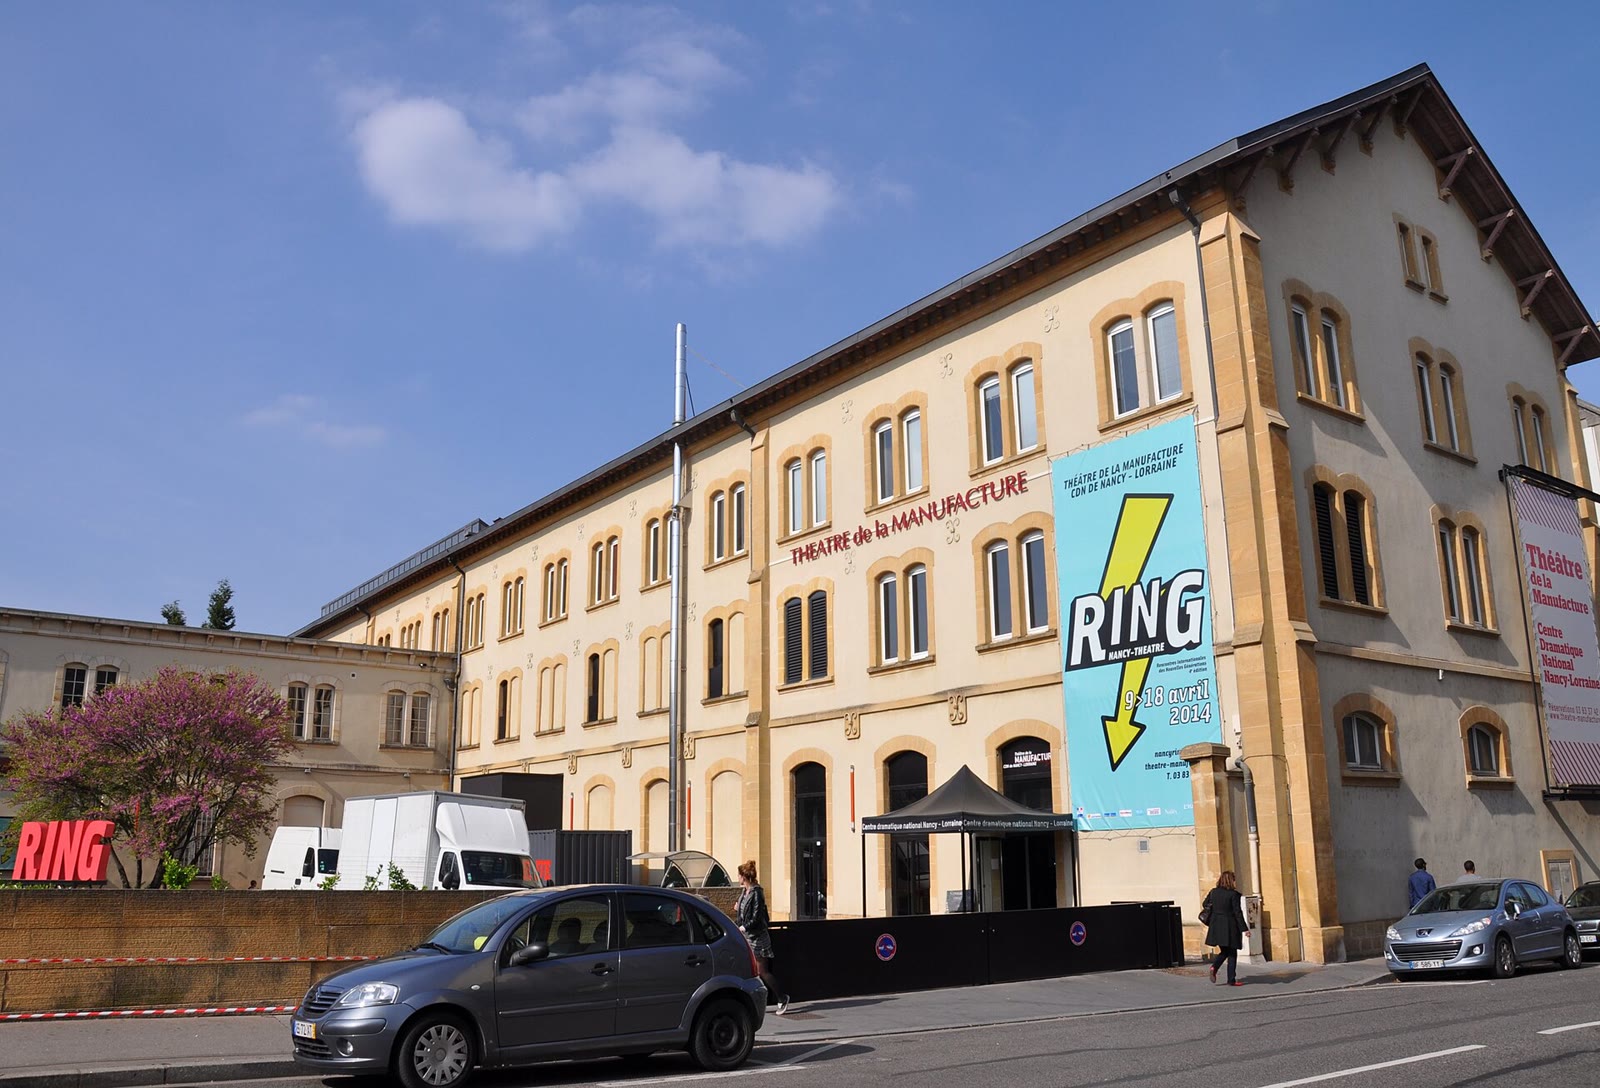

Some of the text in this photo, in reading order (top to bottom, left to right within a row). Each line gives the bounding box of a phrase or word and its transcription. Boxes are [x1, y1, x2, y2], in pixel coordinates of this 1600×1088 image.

[1064, 443, 1184, 489] THÉÂTRE DE LA MANUFACTURE
[1071, 485, 1086, 498] CDN
[1088, 482, 1098, 493] DE
[1100, 473, 1126, 489] NANCY
[1134, 457, 1177, 479] LORRAINE
[789, 470, 1029, 566] THEATRE de la MANUFACTURE
[1525, 543, 1583, 580] Théâtre
[1530, 571, 1552, 589] de la
[1532, 588, 1589, 615] Manufacture
[1068, 569, 1205, 668] RING
[1537, 622, 1563, 638] Centre
[1108, 642, 1165, 661] NANCY-THEATRE
[1539, 637, 1583, 659] Dramatique
[1541, 653, 1575, 671] National
[1168, 678, 1209, 704] avril
[1543, 670, 1600, 690] Nancy-Lorraine
[1169, 702, 1211, 725] 2014
[1173, 771, 1181, 779] 03
[1182, 770, 1190, 779] 83
[877, 822, 902, 831] dramatique
[903, 821, 922, 829] national
[923, 821, 938, 829] Nancy
[941, 819, 962, 827] Lorraine
[982, 820, 1011, 828] dramatique
[1012, 820, 1033, 828] national
[1034, 820, 1049, 828] Nancy
[12, 820, 115, 881] RING
